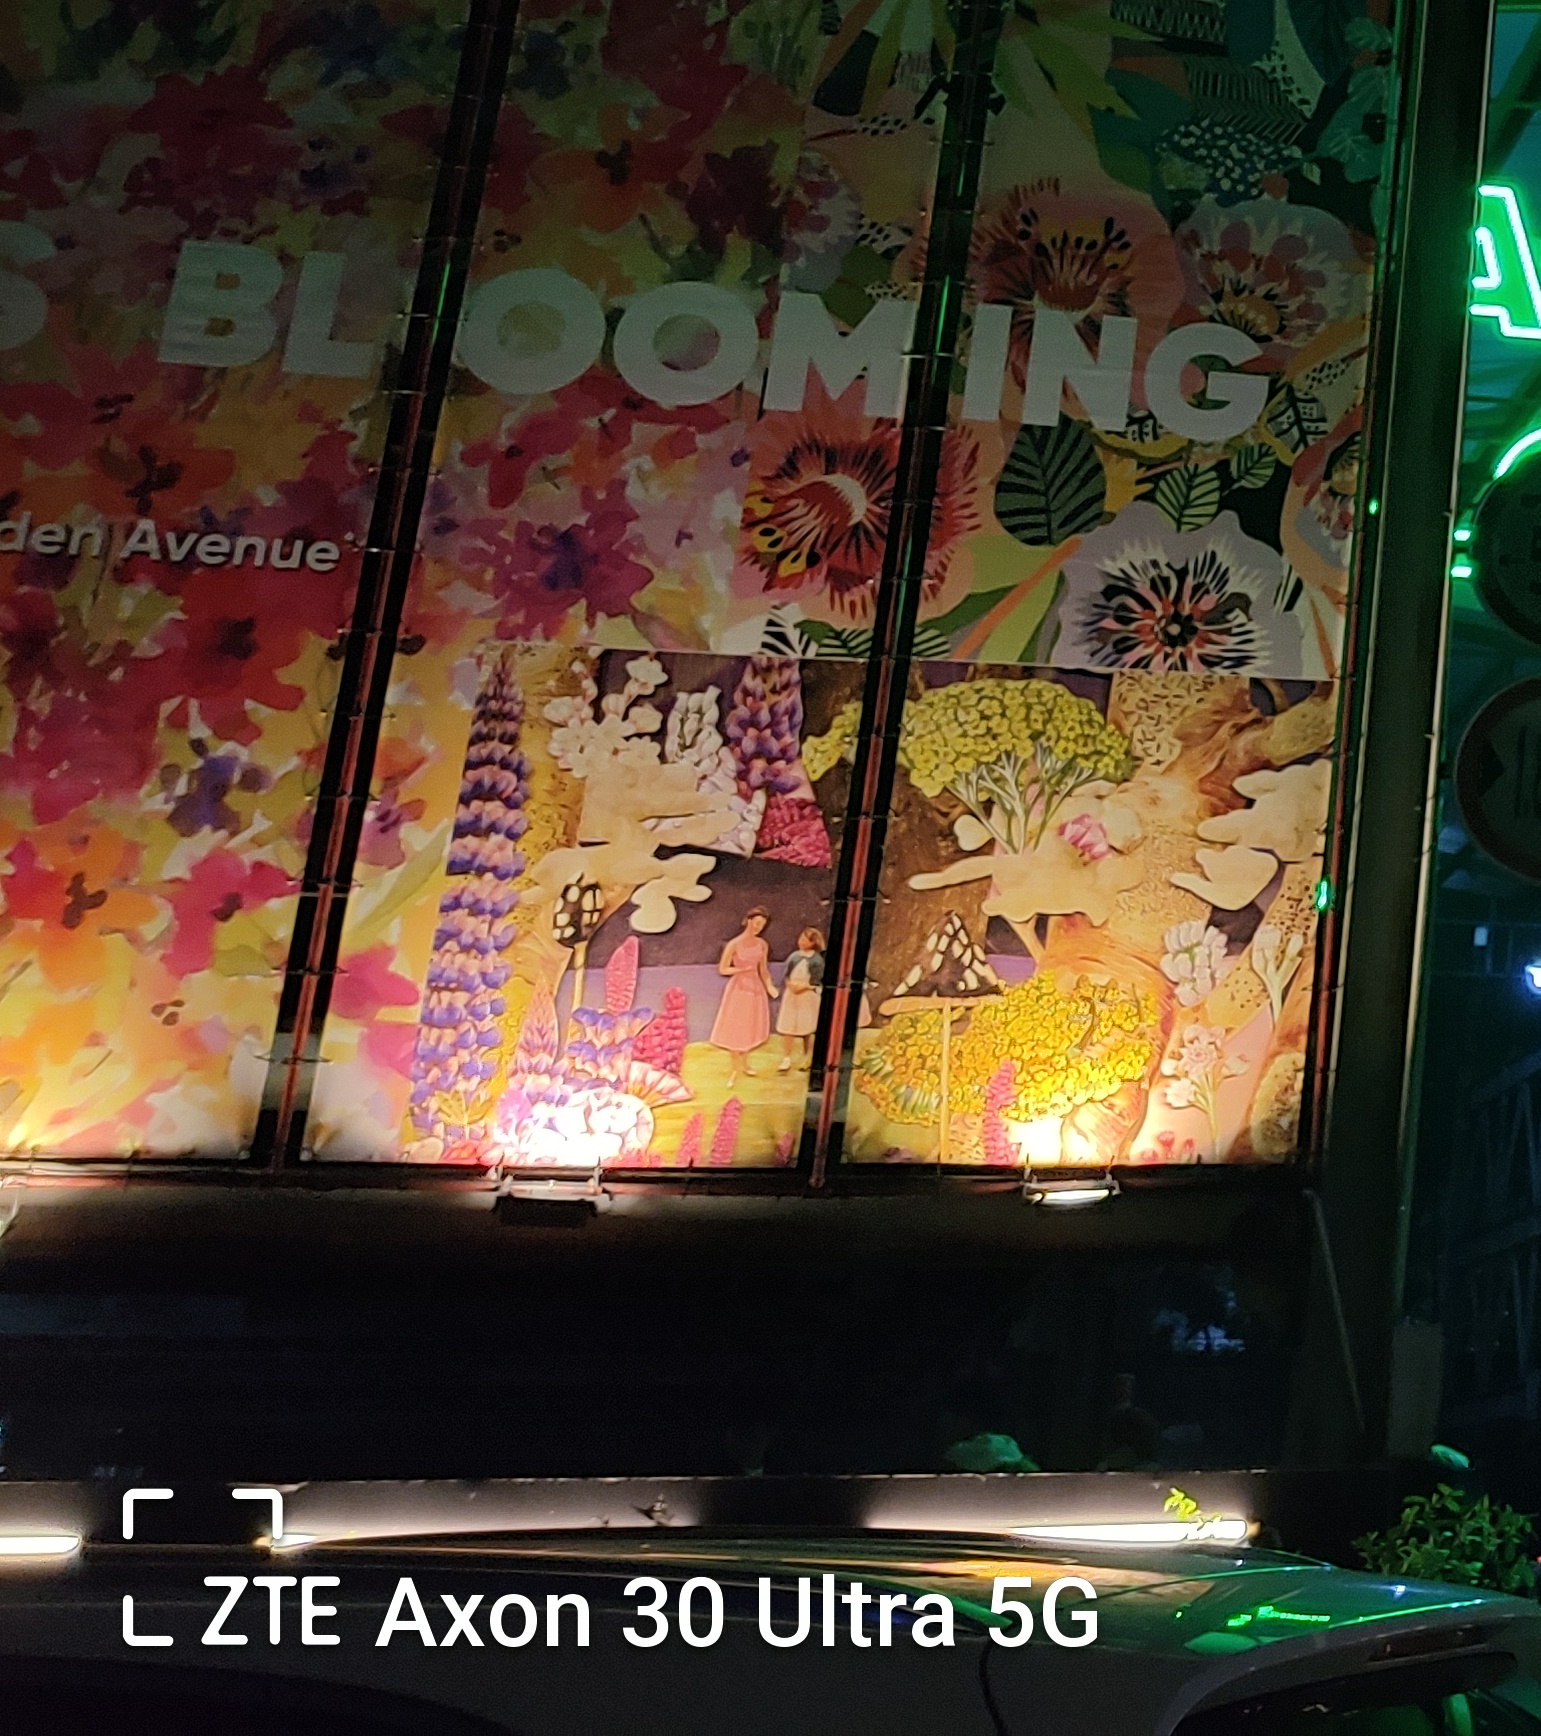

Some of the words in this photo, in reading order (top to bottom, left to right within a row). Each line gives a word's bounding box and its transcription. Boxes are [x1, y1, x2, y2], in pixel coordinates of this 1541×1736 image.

[157, 238, 1270, 441] BLOOMING
[0, 511, 103, 557] den
[120, 518, 341, 572] Avenue
